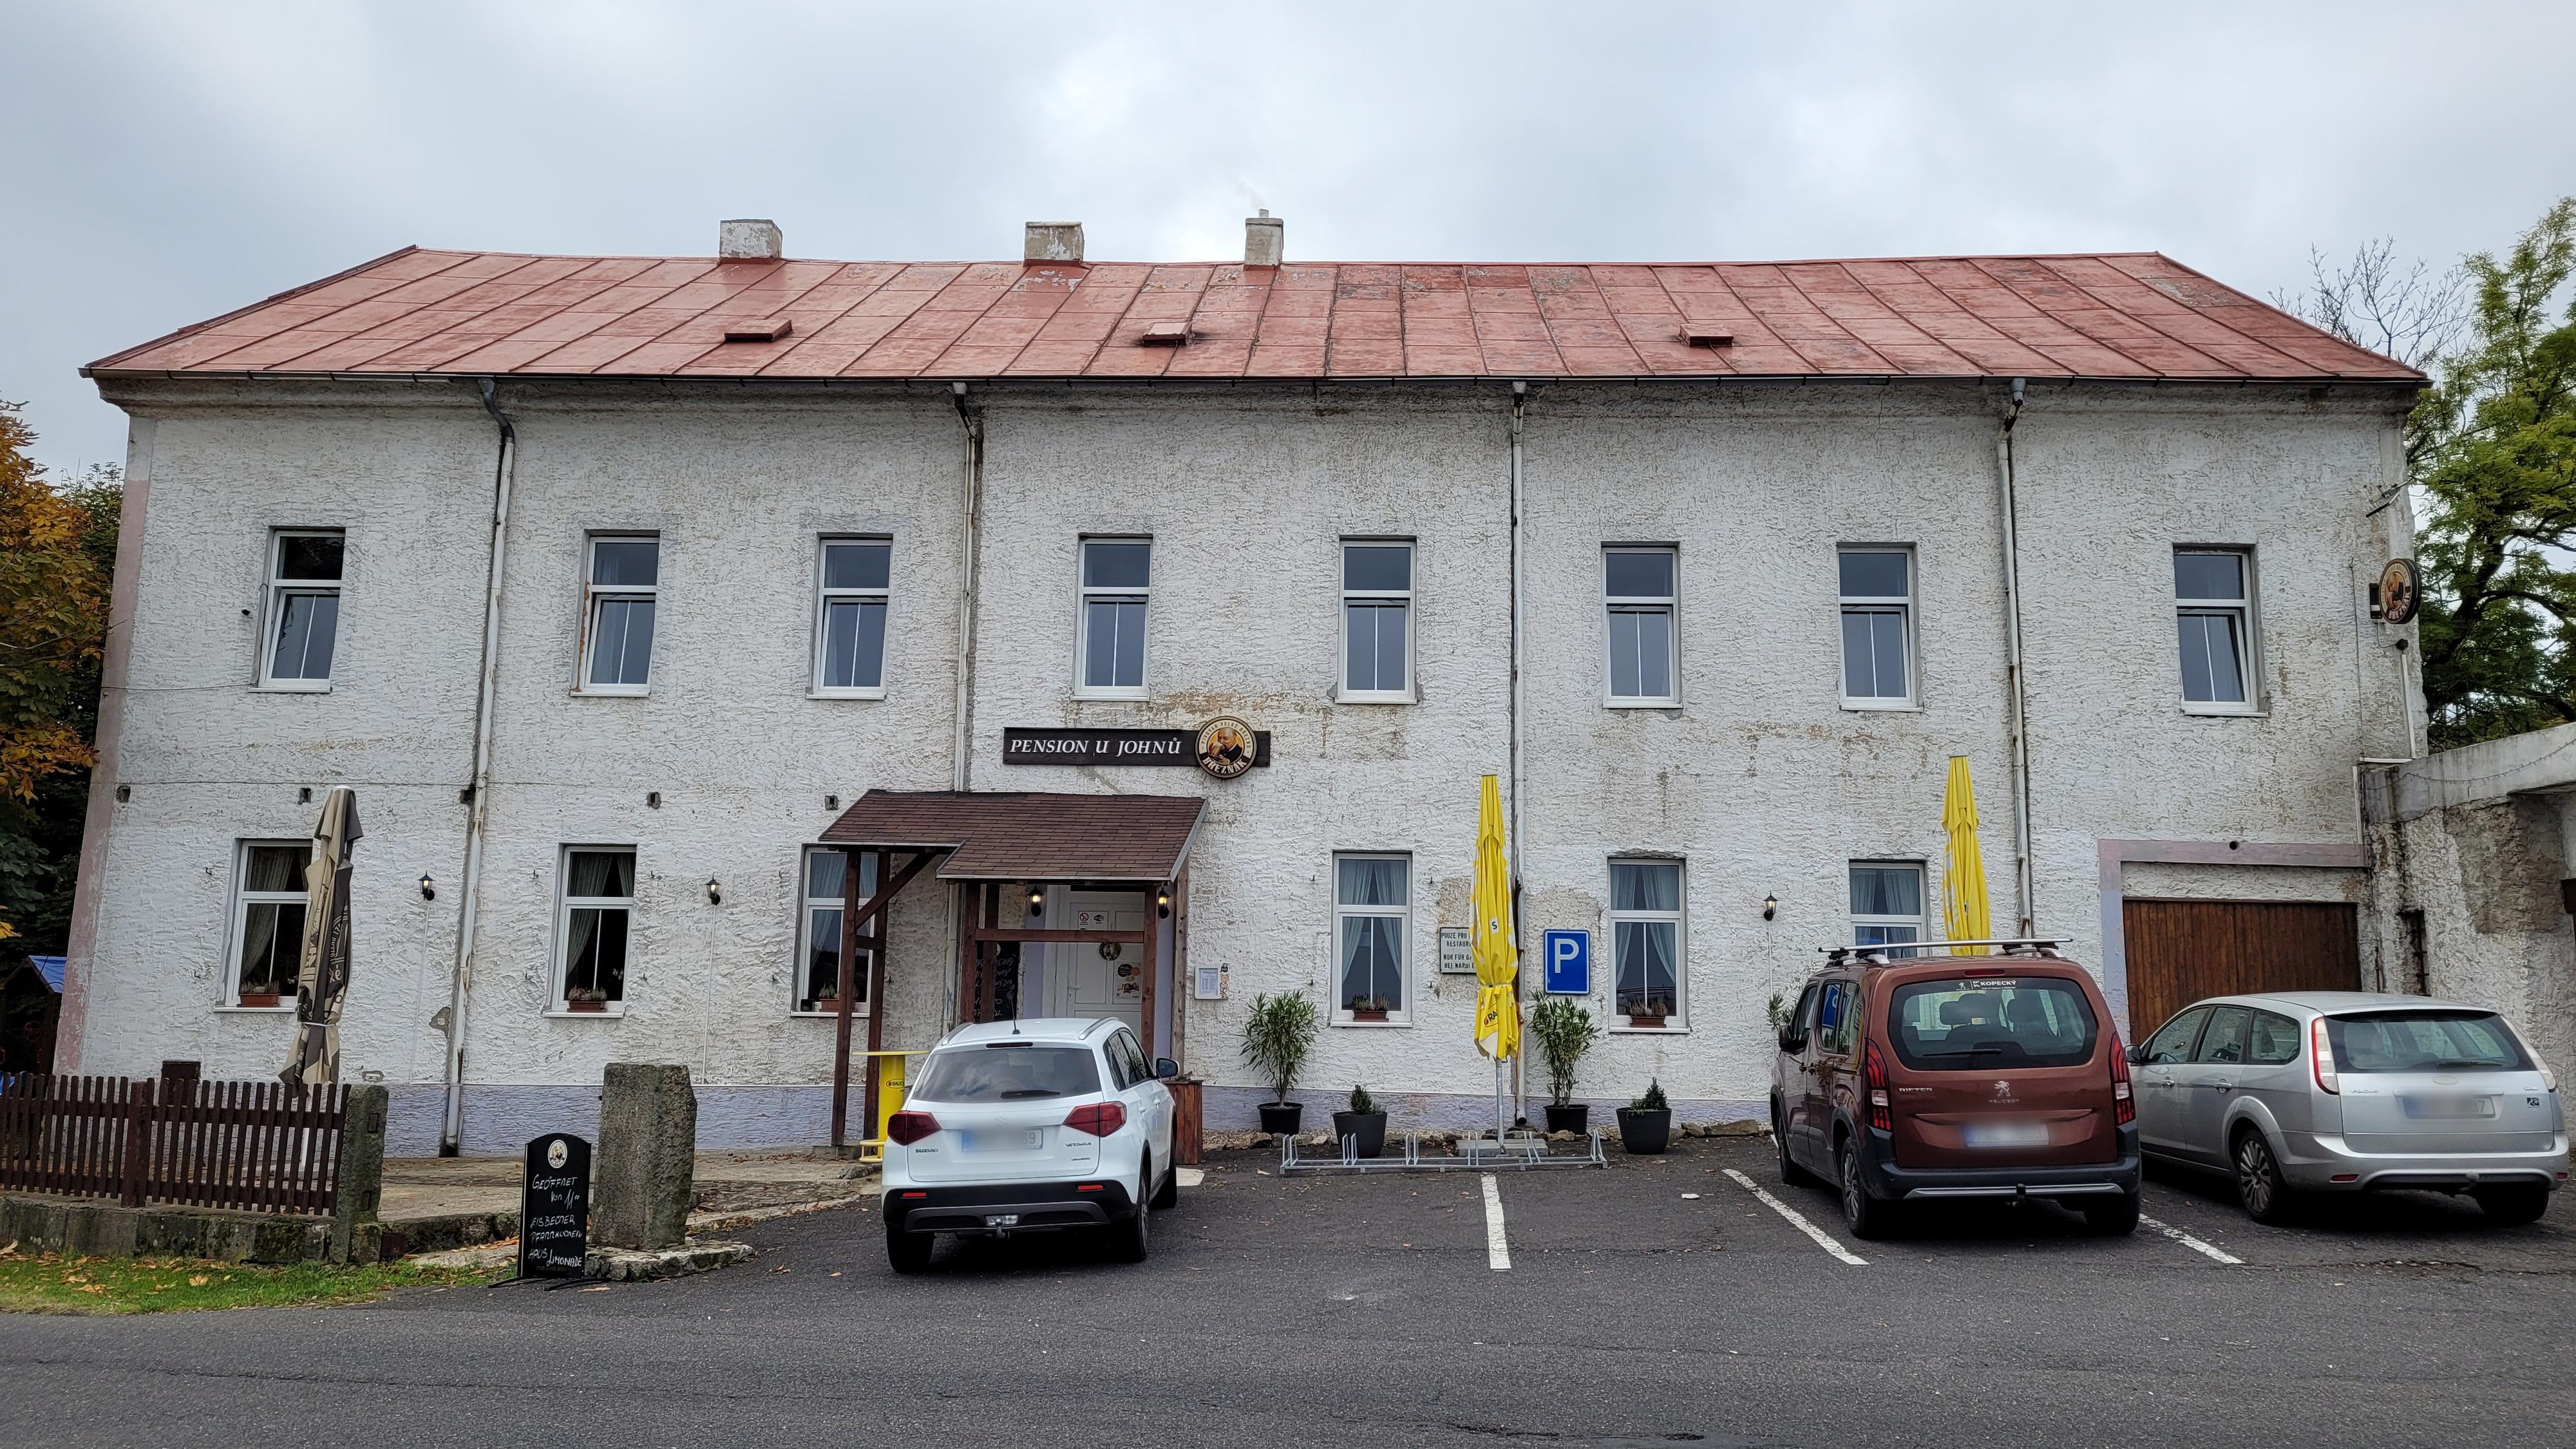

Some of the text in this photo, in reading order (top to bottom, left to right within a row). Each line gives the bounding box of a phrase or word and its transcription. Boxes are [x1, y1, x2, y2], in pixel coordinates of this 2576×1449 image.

[1009, 737, 1182, 757] PENSION U JOHNŮ
[1492, 921, 1498, 930] S
[1554, 938, 1580, 974] P
[1487, 1010, 1498, 1022] RA
